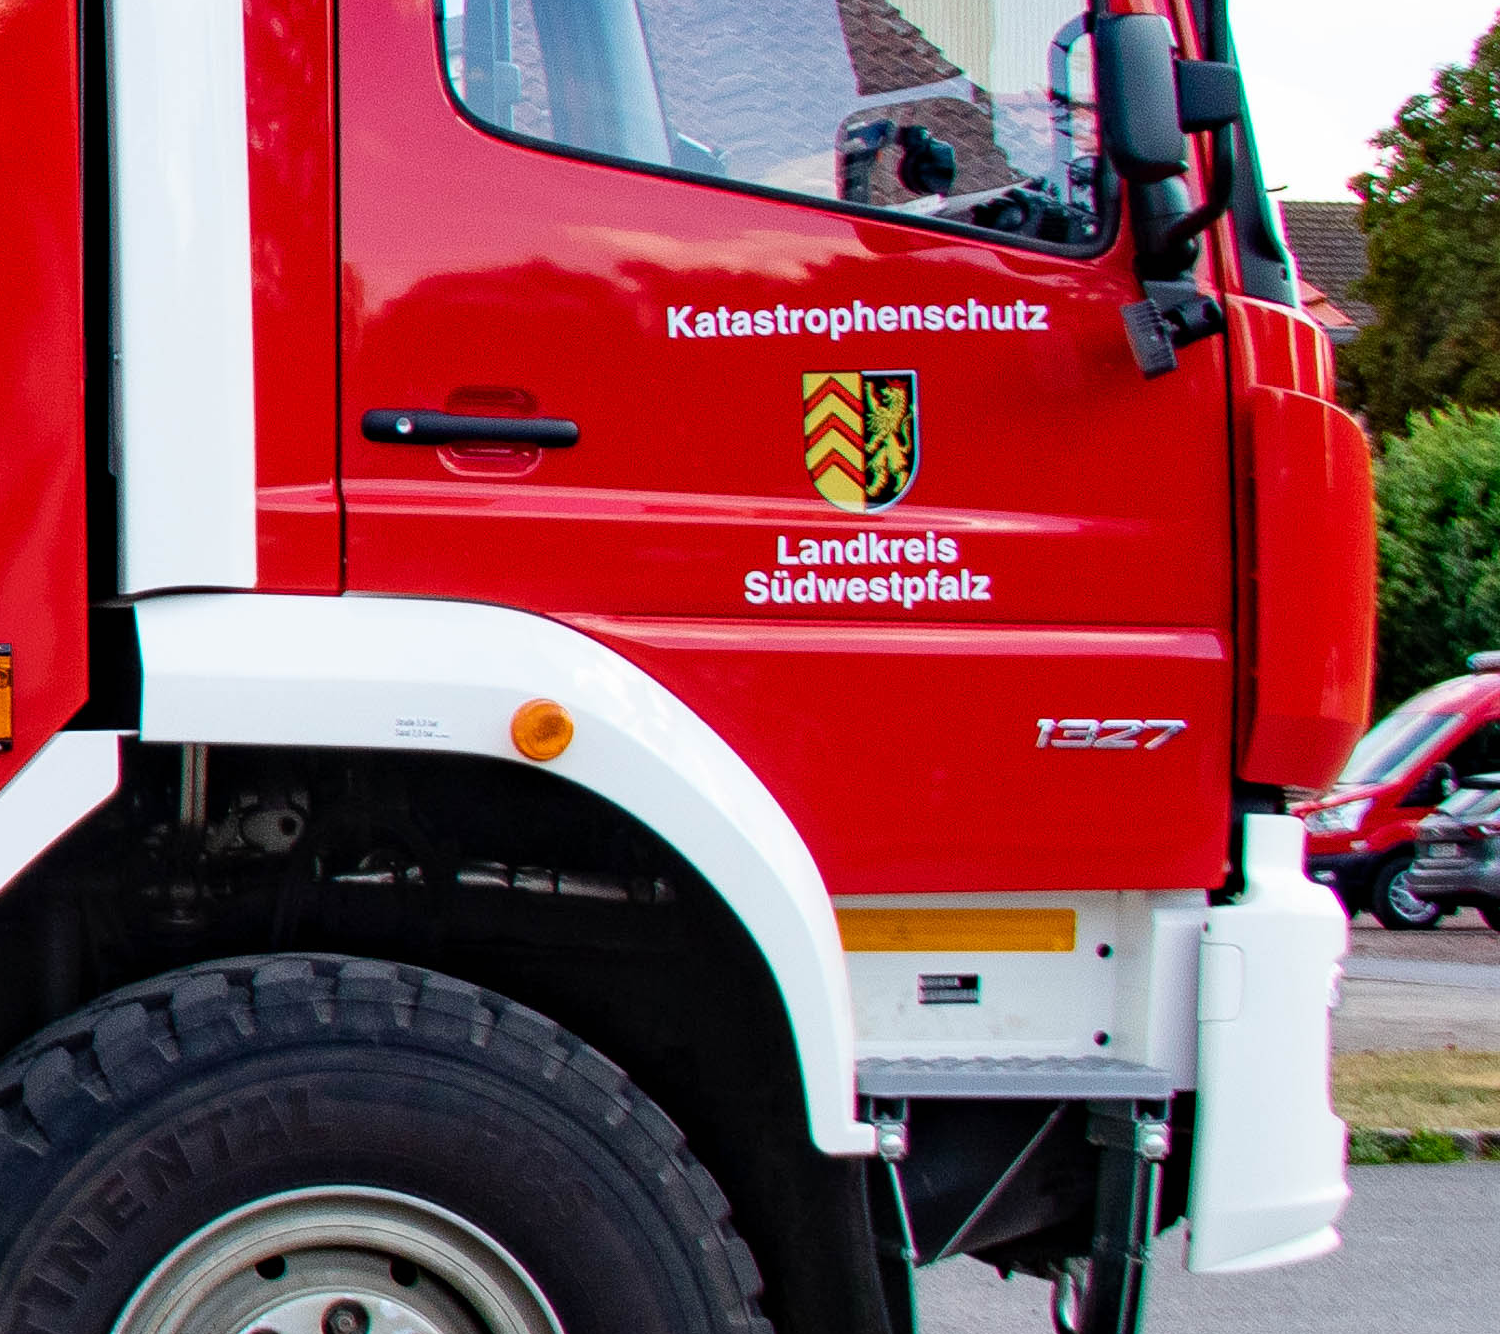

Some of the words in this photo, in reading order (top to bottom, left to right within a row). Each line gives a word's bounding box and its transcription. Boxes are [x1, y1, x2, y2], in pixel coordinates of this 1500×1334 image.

[666, 299, 1049, 342] Katastrophenschutz
[776, 529, 959, 566] Landkreis
[743, 567, 993, 610] Südwestpfalz
[1035, 717, 1187, 751] 1327
